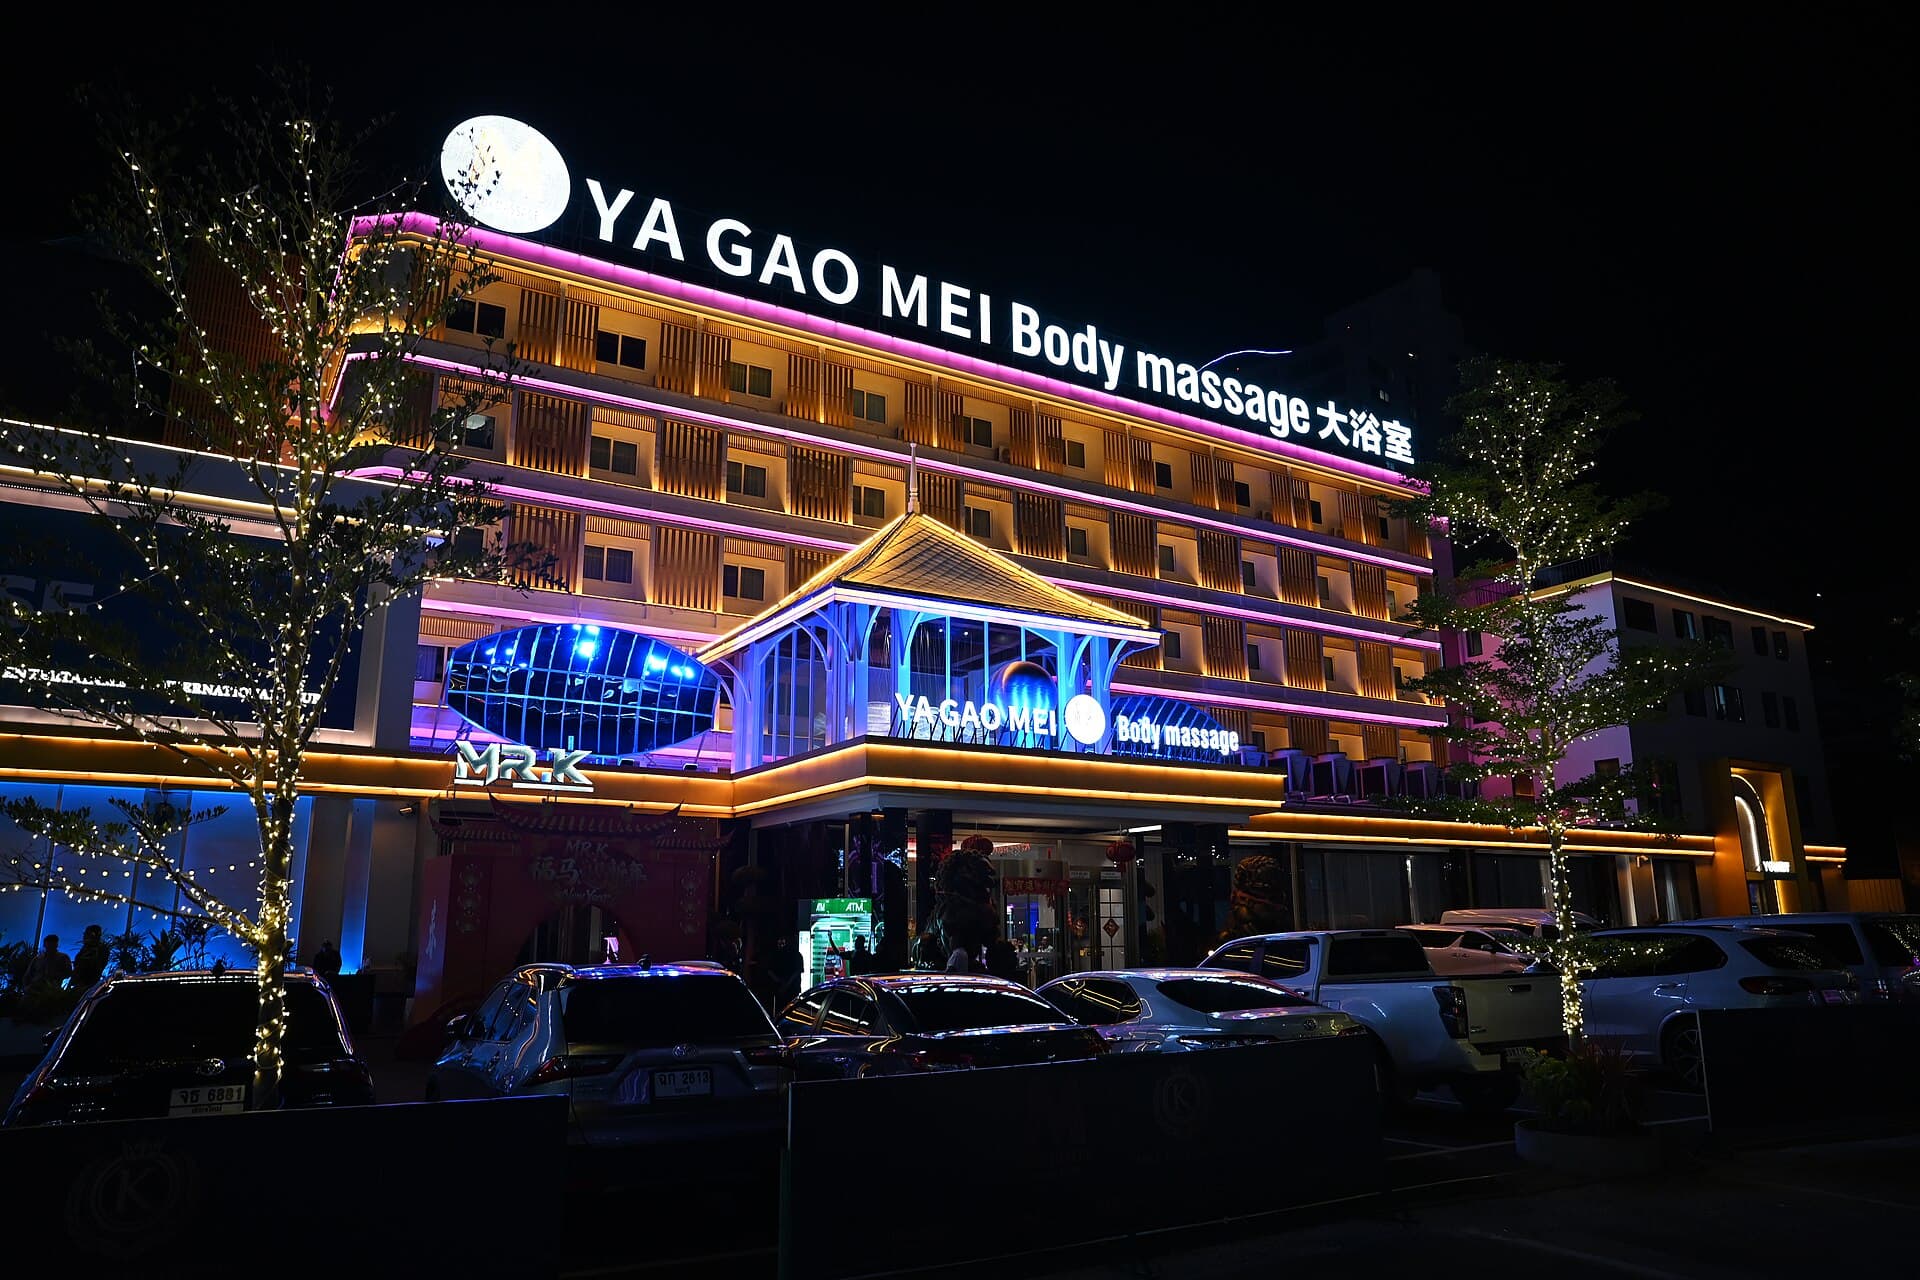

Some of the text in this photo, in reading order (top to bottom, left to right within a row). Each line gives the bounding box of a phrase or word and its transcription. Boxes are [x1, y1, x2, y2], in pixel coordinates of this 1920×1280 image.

[586, 178, 1415, 465] YA GAO MEI Body massage 大浴室
[894, 692, 1239, 756] YA GAO MEI Body massage
[455, 740, 594, 786] MR.K
[845, 902, 864, 912] ATM
